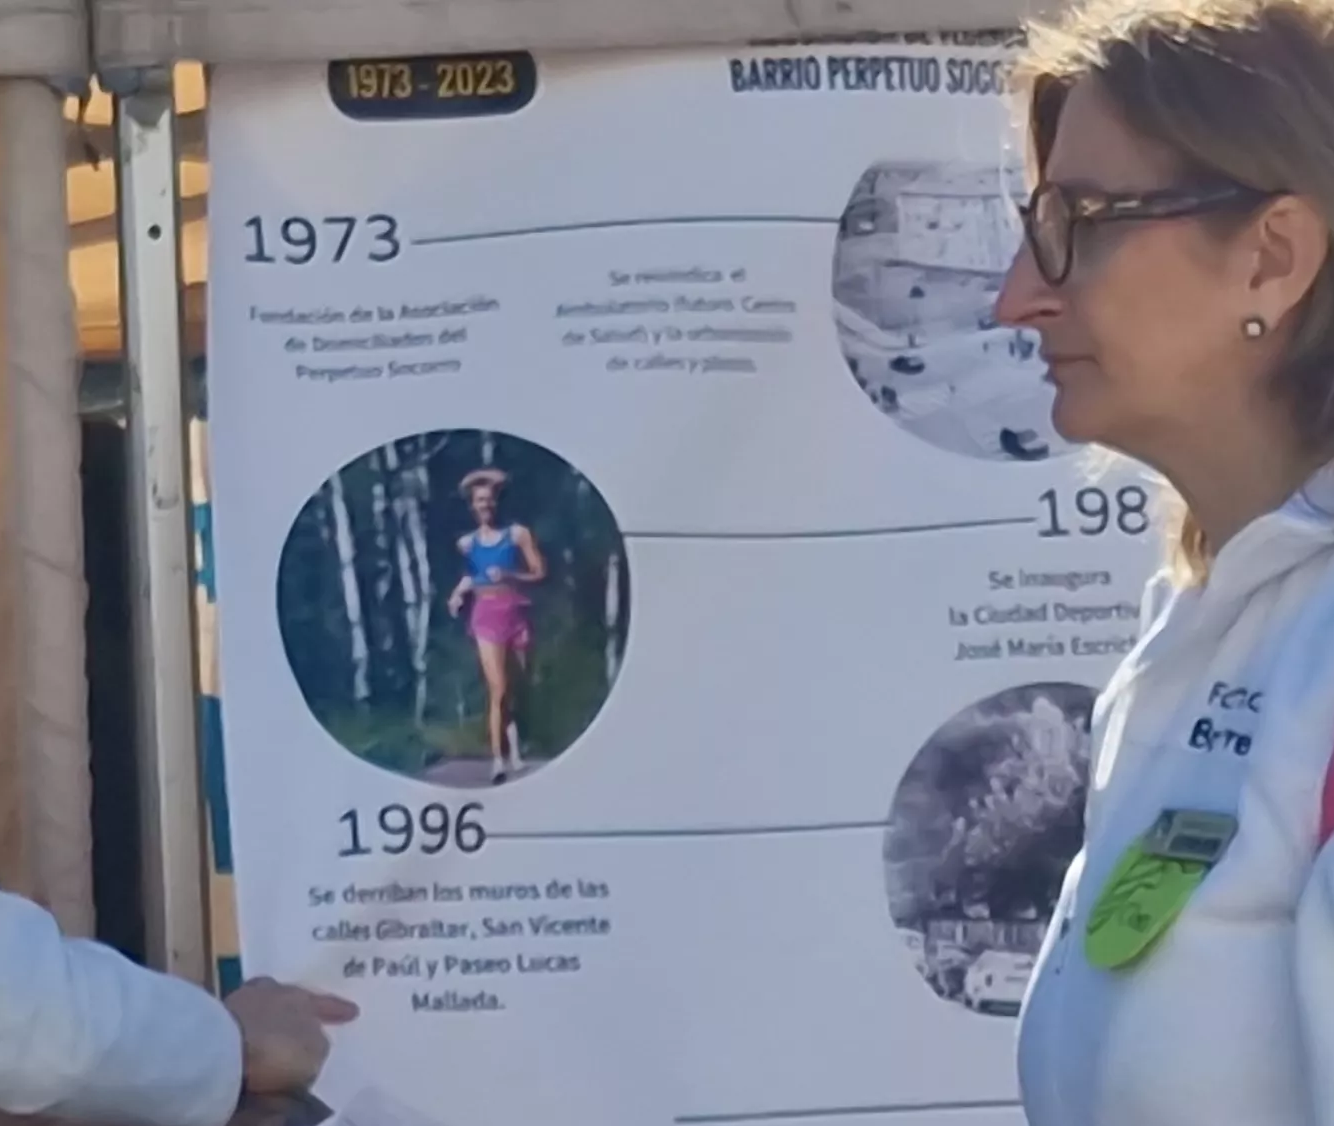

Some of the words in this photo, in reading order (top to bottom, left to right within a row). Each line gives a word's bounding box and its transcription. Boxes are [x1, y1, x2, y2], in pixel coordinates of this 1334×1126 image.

[347, 62, 413, 99] 1973
[436, 60, 516, 98] 2023
[729, 56, 821, 93] BARRIO
[826, 55, 940, 93] PERPETUO
[244, 213, 401, 265] 1973
[1038, 485, 1150, 537] 198
[337, 802, 487, 857] 1996
[308, 885, 336, 907] Se
[341, 881, 429, 903] derriban
[432, 882, 464, 902] los
[468, 883, 541, 901] muros
[544, 879, 574, 899] de
[576, 878, 610, 898] las
[311, 919, 371, 942] calles
[482, 917, 524, 938] San
[527, 914, 612, 936] Vicente
[342, 957, 367, 978] de
[371, 953, 421, 978] Paúl
[426, 962, 439, 980] y
[443, 954, 512, 975] Paseo
[516, 953, 581, 973] Lucas
[411, 990, 507, 1013] Mallada.
